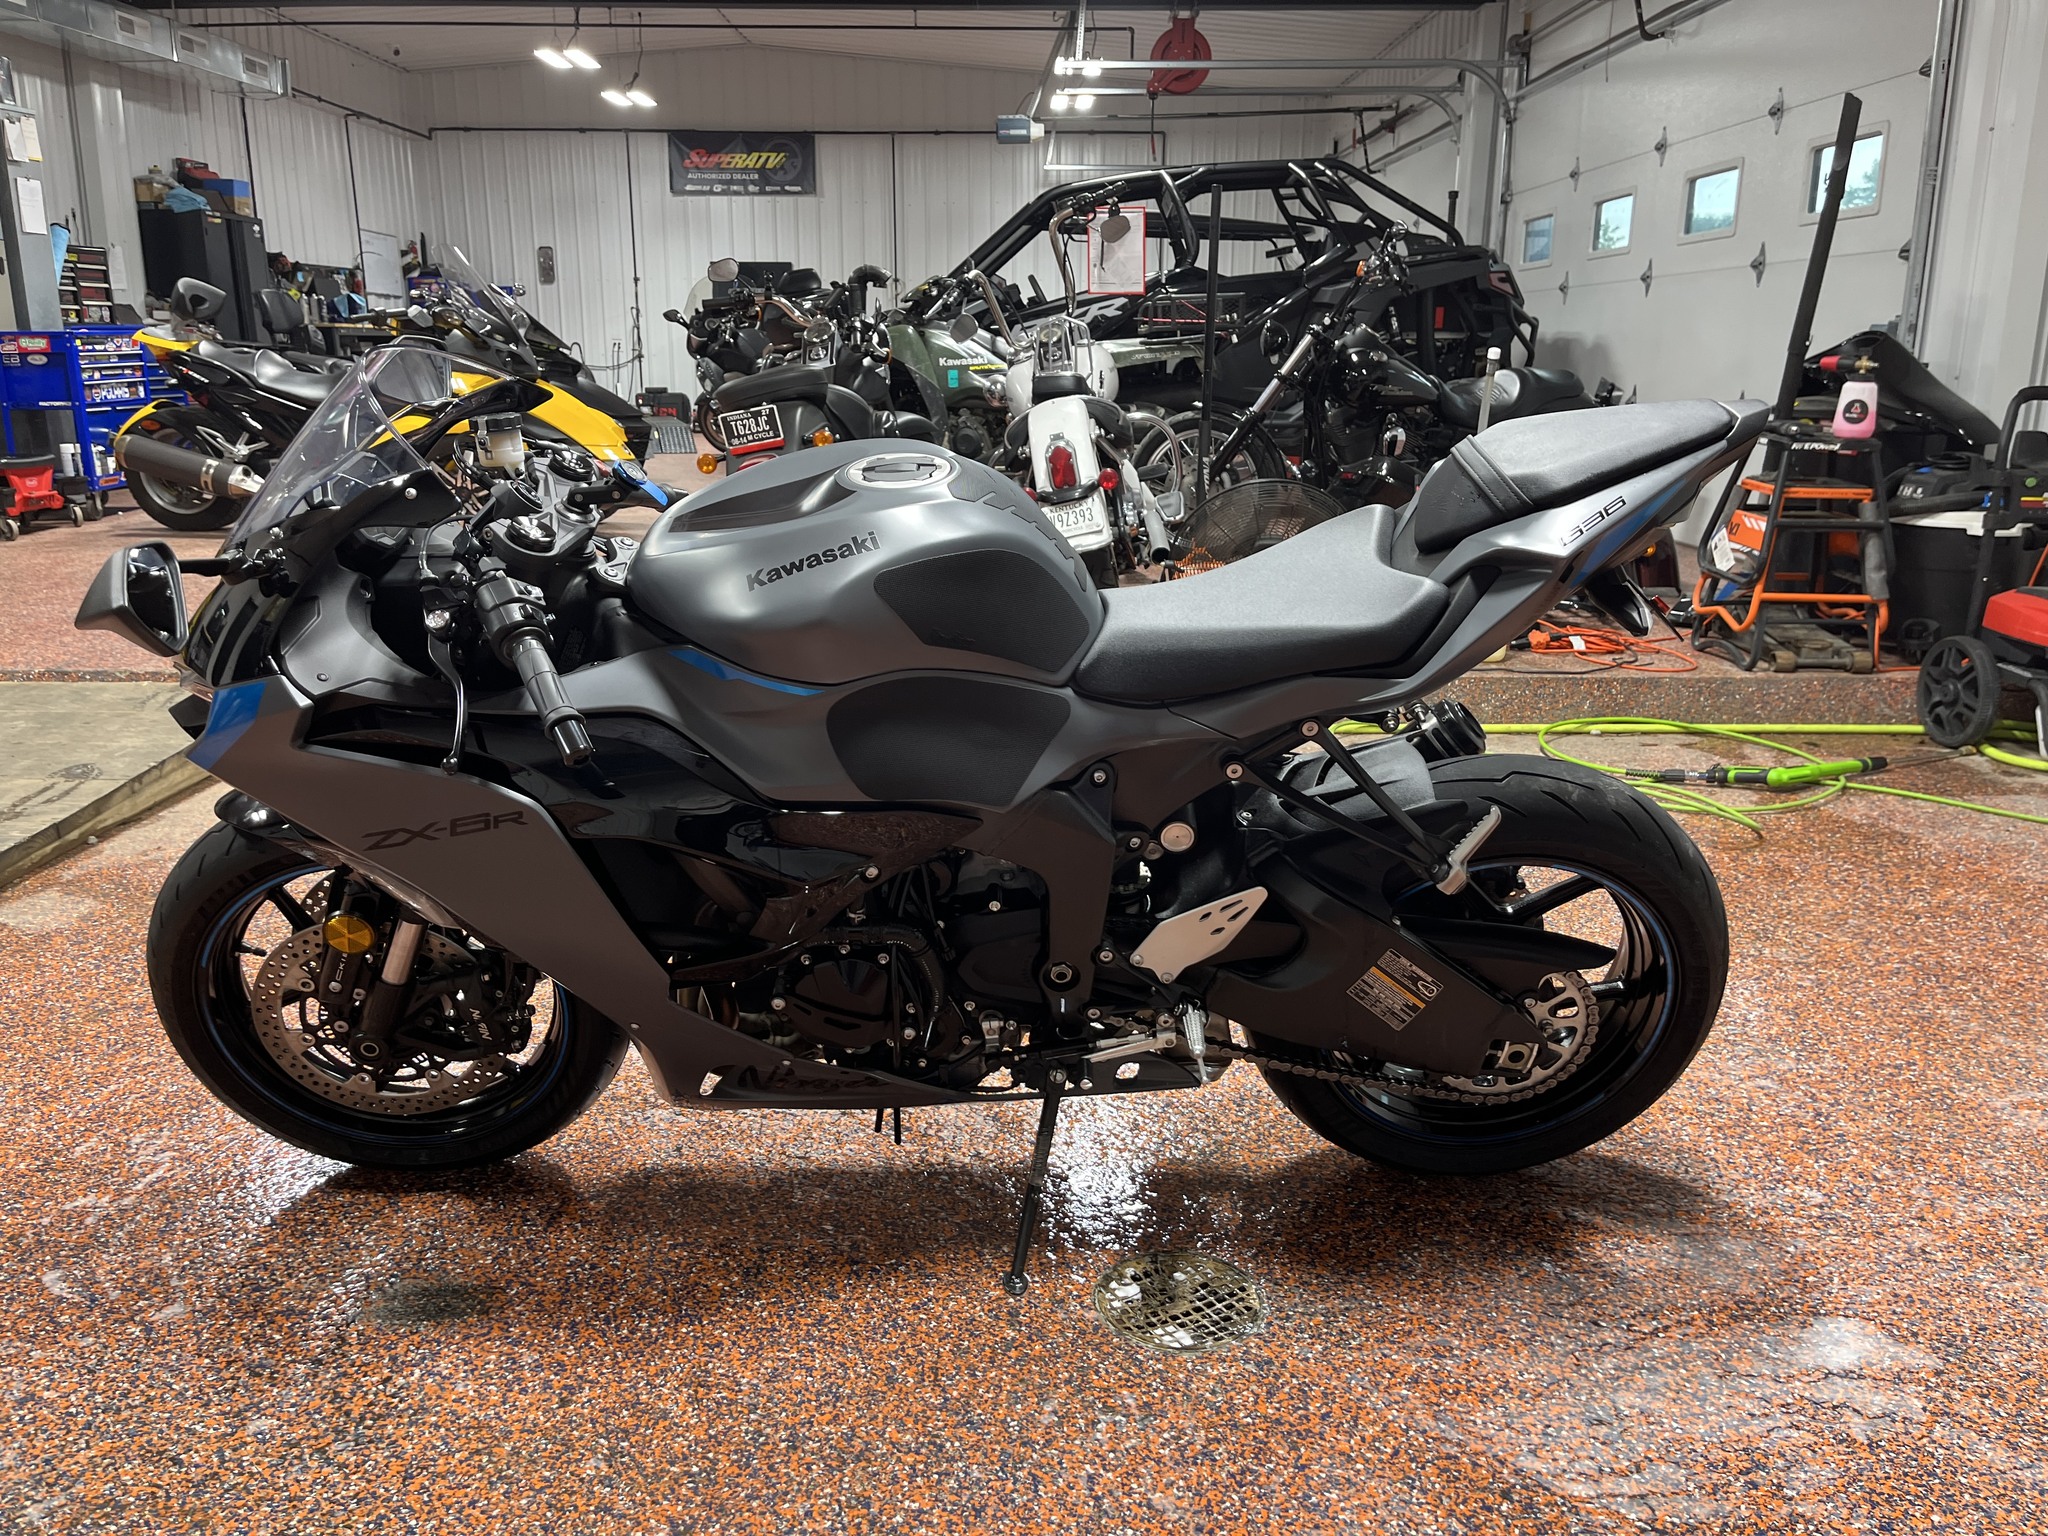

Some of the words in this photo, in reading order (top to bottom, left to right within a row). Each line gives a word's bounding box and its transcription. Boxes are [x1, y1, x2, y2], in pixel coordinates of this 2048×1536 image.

[939, 356, 988, 366] Kawasaki
[727, 412, 752, 421] INDIANA
[761, 408, 769, 416] 27
[730, 416, 770, 437] T628JC
[754, 430, 775, 440] CYCLE
[1050, 501, 1090, 514] KENTUCKY
[746, 530, 882, 592] Kawasaki
[361, 810, 529, 851] ZX-6R
